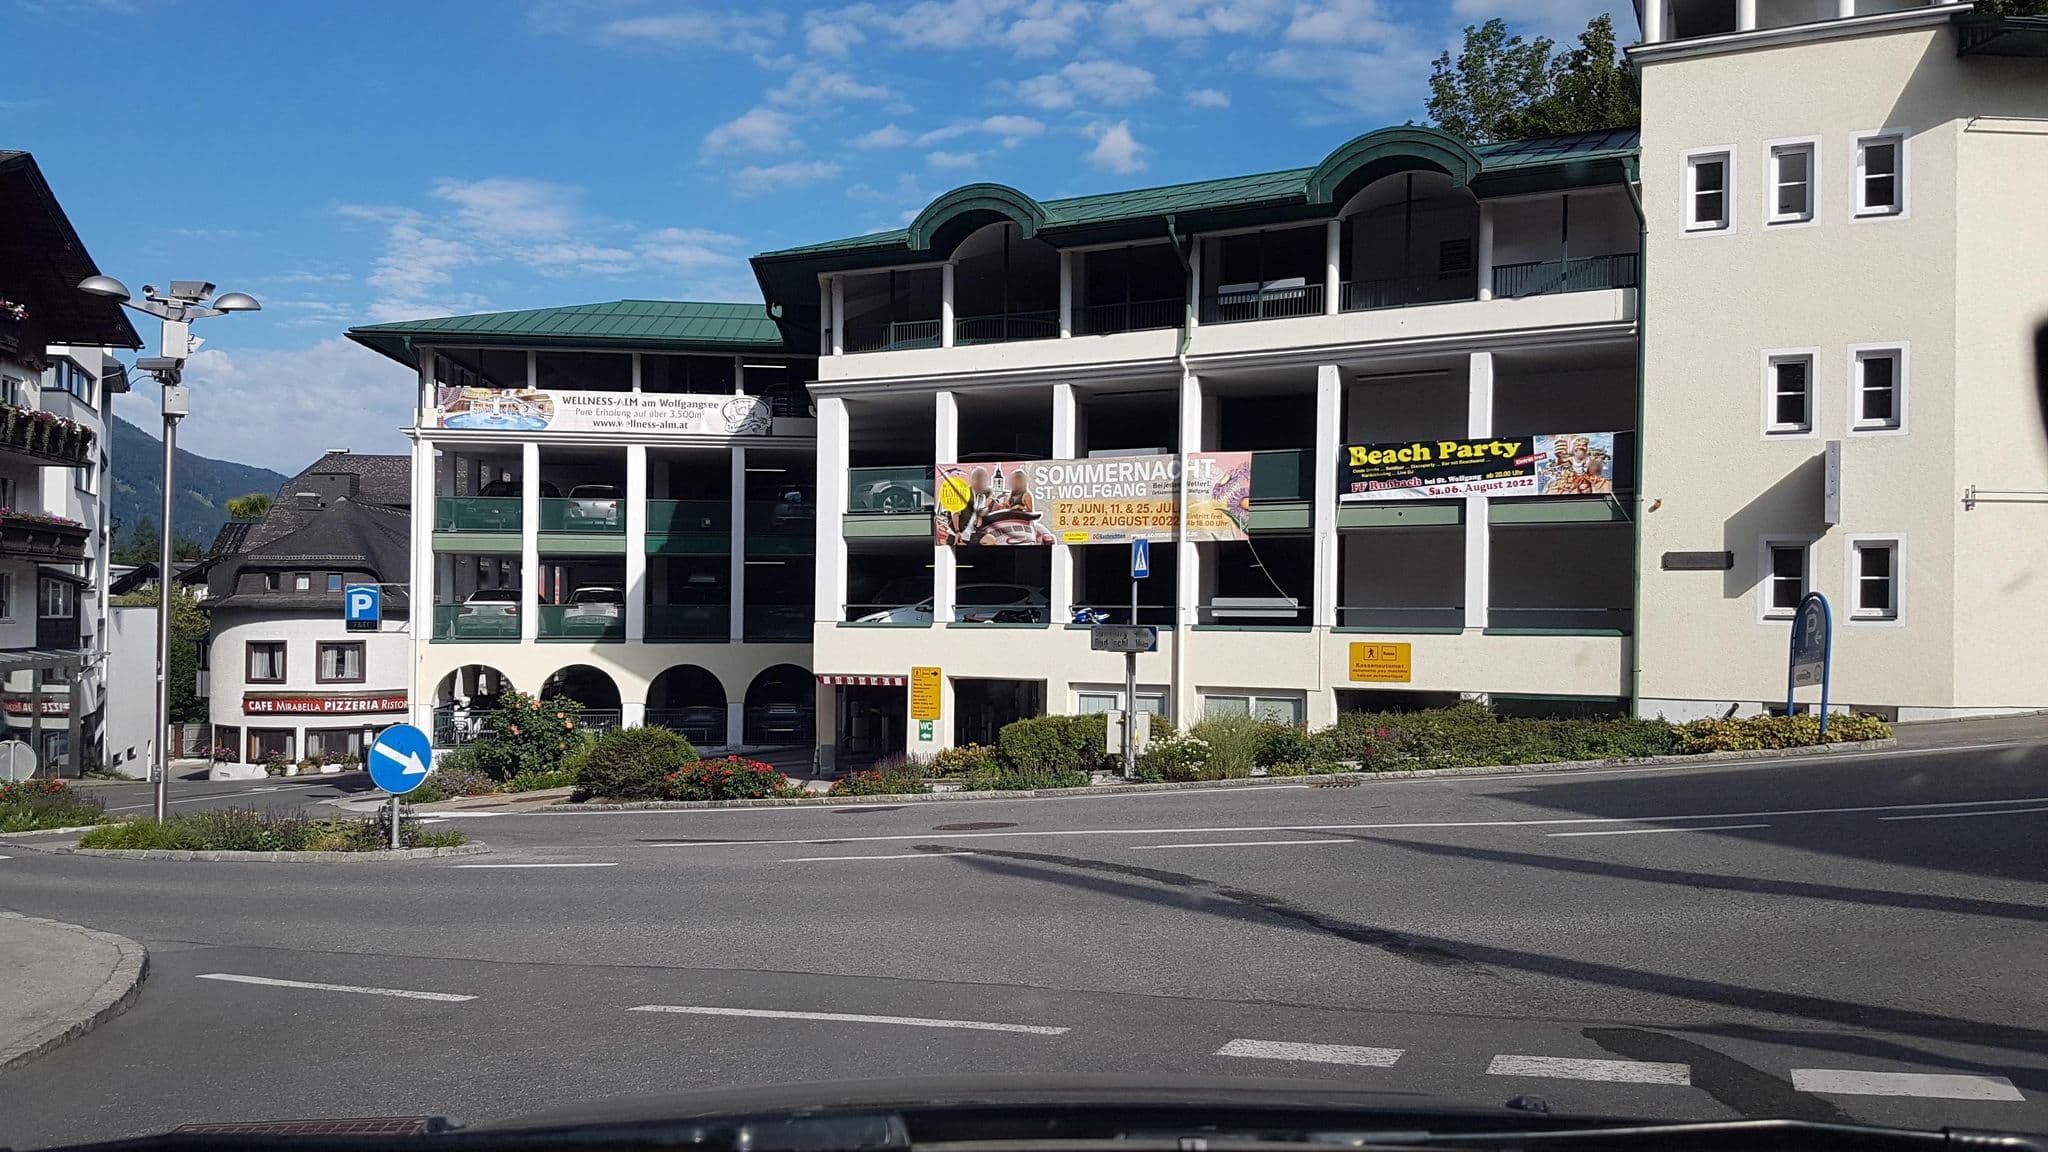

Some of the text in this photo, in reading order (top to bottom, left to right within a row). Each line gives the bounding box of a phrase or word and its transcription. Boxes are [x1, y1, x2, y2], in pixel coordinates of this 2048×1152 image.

[562, 396, 638, 407] WELLNESS-ALM
[659, 399, 719, 410] Wolfgangsee
[575, 408, 592, 416] Pure
[596, 408, 631, 418] Erholung
[649, 409, 666, 418] über
[1348, 441, 1521, 467] Beach Party
[1035, 458, 1217, 486] SOMMERNACHT
[1351, 482, 1368, 493] FF
[1369, 477, 1422, 491] Rußbach
[1437, 477, 1447, 485] St.
[1447, 474, 1482, 483] Wolfgang
[1465, 481, 1503, 493] August
[1507, 479, 1533, 488] 2022
[1058, 483, 1146, 499] WOLFGANG
[1060, 504, 1075, 514] 27.
[1077, 503, 1108, 515] JUNI,
[1110, 503, 1123, 514] 11.
[1125, 503, 1134, 513] &
[1136, 503, 1153, 513] 25.
[1059, 515, 1181, 526] 8. & 22. AUGUST 2022
[352, 594, 373, 618] P
[249, 700, 273, 711] CAFE
[324, 699, 379, 711] PIZZERIA
[920, 721, 932, 731] WC
